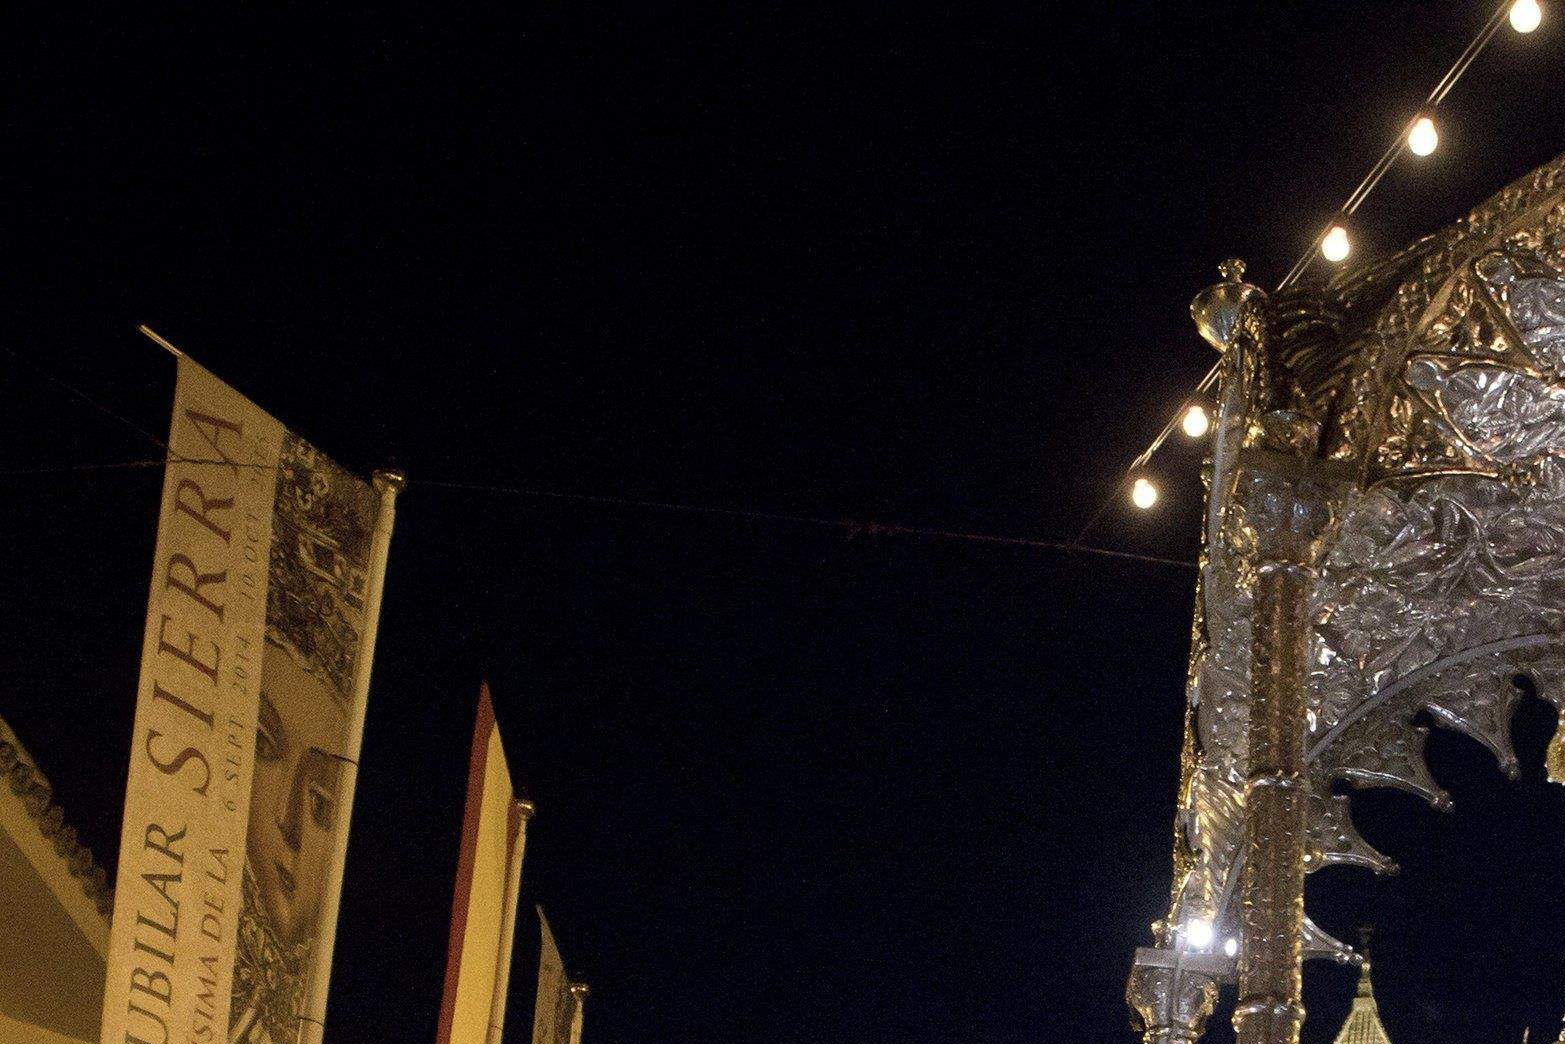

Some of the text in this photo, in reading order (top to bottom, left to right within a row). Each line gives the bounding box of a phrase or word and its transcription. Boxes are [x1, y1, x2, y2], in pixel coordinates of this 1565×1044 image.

[146, 409, 243, 797] SIERRA
[241, 574, 256, 602] 10
[233, 635, 250, 694] 2014
[225, 800, 236, 811] 6
[206, 849, 229, 884] LA
[201, 896, 224, 942] DE
